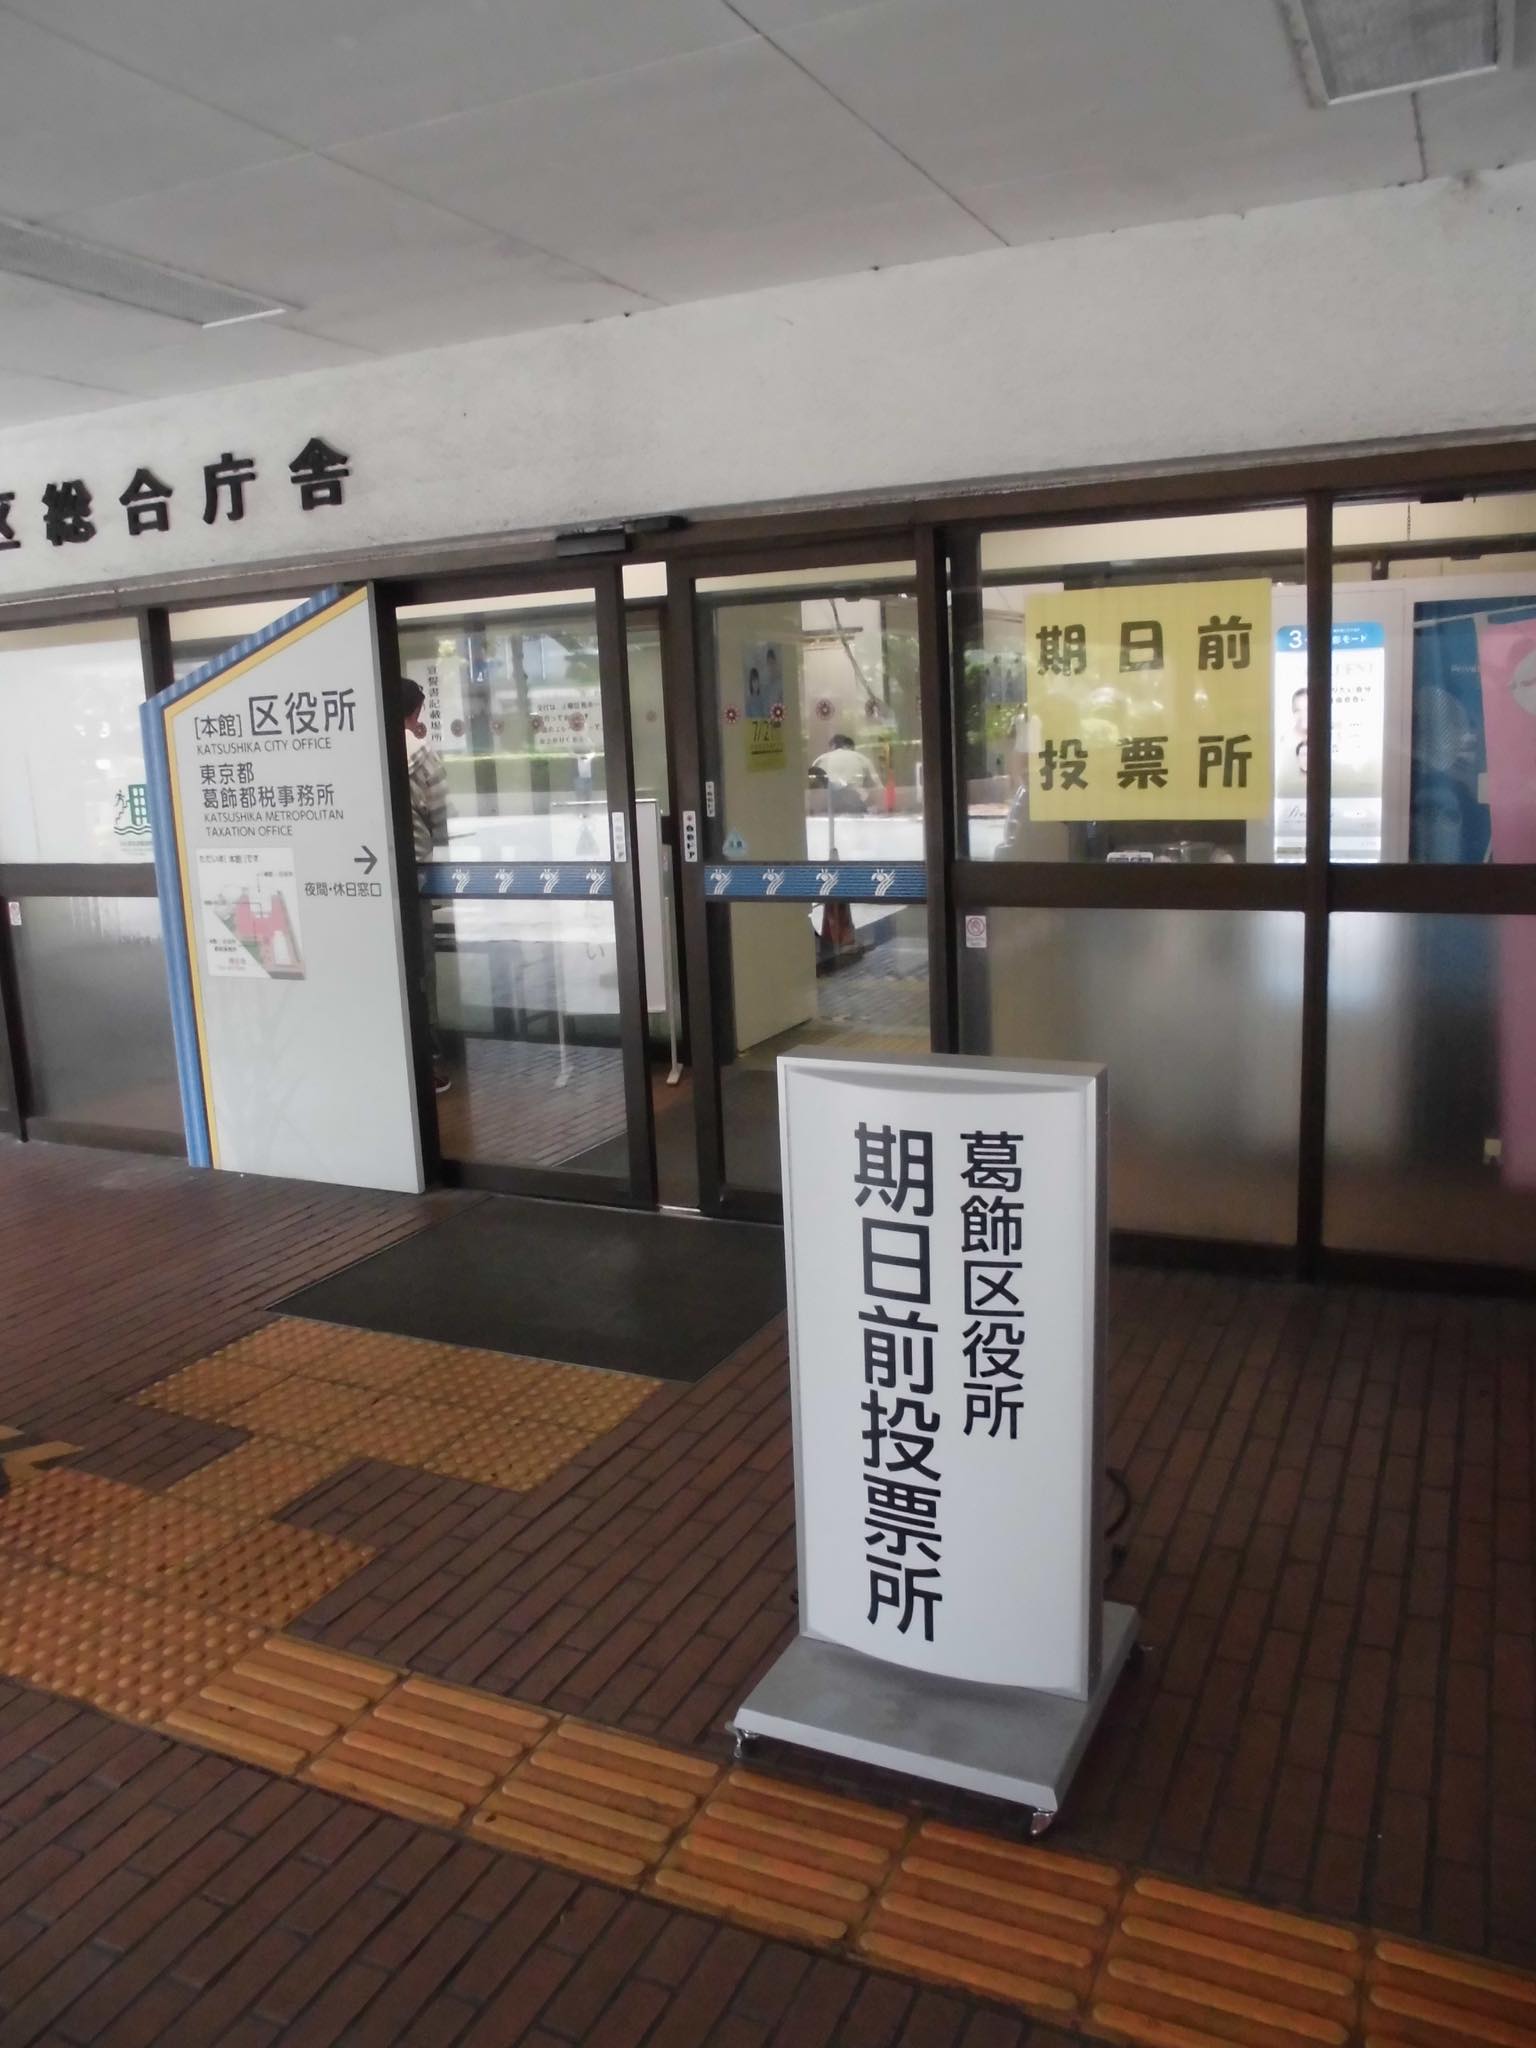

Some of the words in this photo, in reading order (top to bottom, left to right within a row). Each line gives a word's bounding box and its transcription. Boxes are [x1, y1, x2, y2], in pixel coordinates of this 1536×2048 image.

[1035, 615, 1253, 676] 期日前
[249, 688, 356, 736] 区役所
[196, 741, 262, 755] KATSUSHIKA
[264, 739, 288, 752] CITY
[292, 737, 332, 751] OFFICE
[200, 762, 254, 785] 東京都
[1038, 734, 1253, 791] 投票所
[203, 784, 335, 808] 葛飾都税事務所
[204, 812, 263, 823] KATSUSHIKA
[265, 809, 344, 822] METROPOLITAN
[258, 825, 293, 836] OFFICE
[304, 883, 382, 897] 夜間・休日窓口
[960, 1131, 1024, 1439] 葛飾区役所
[854, 1122, 942, 1641] 期日前投票所
